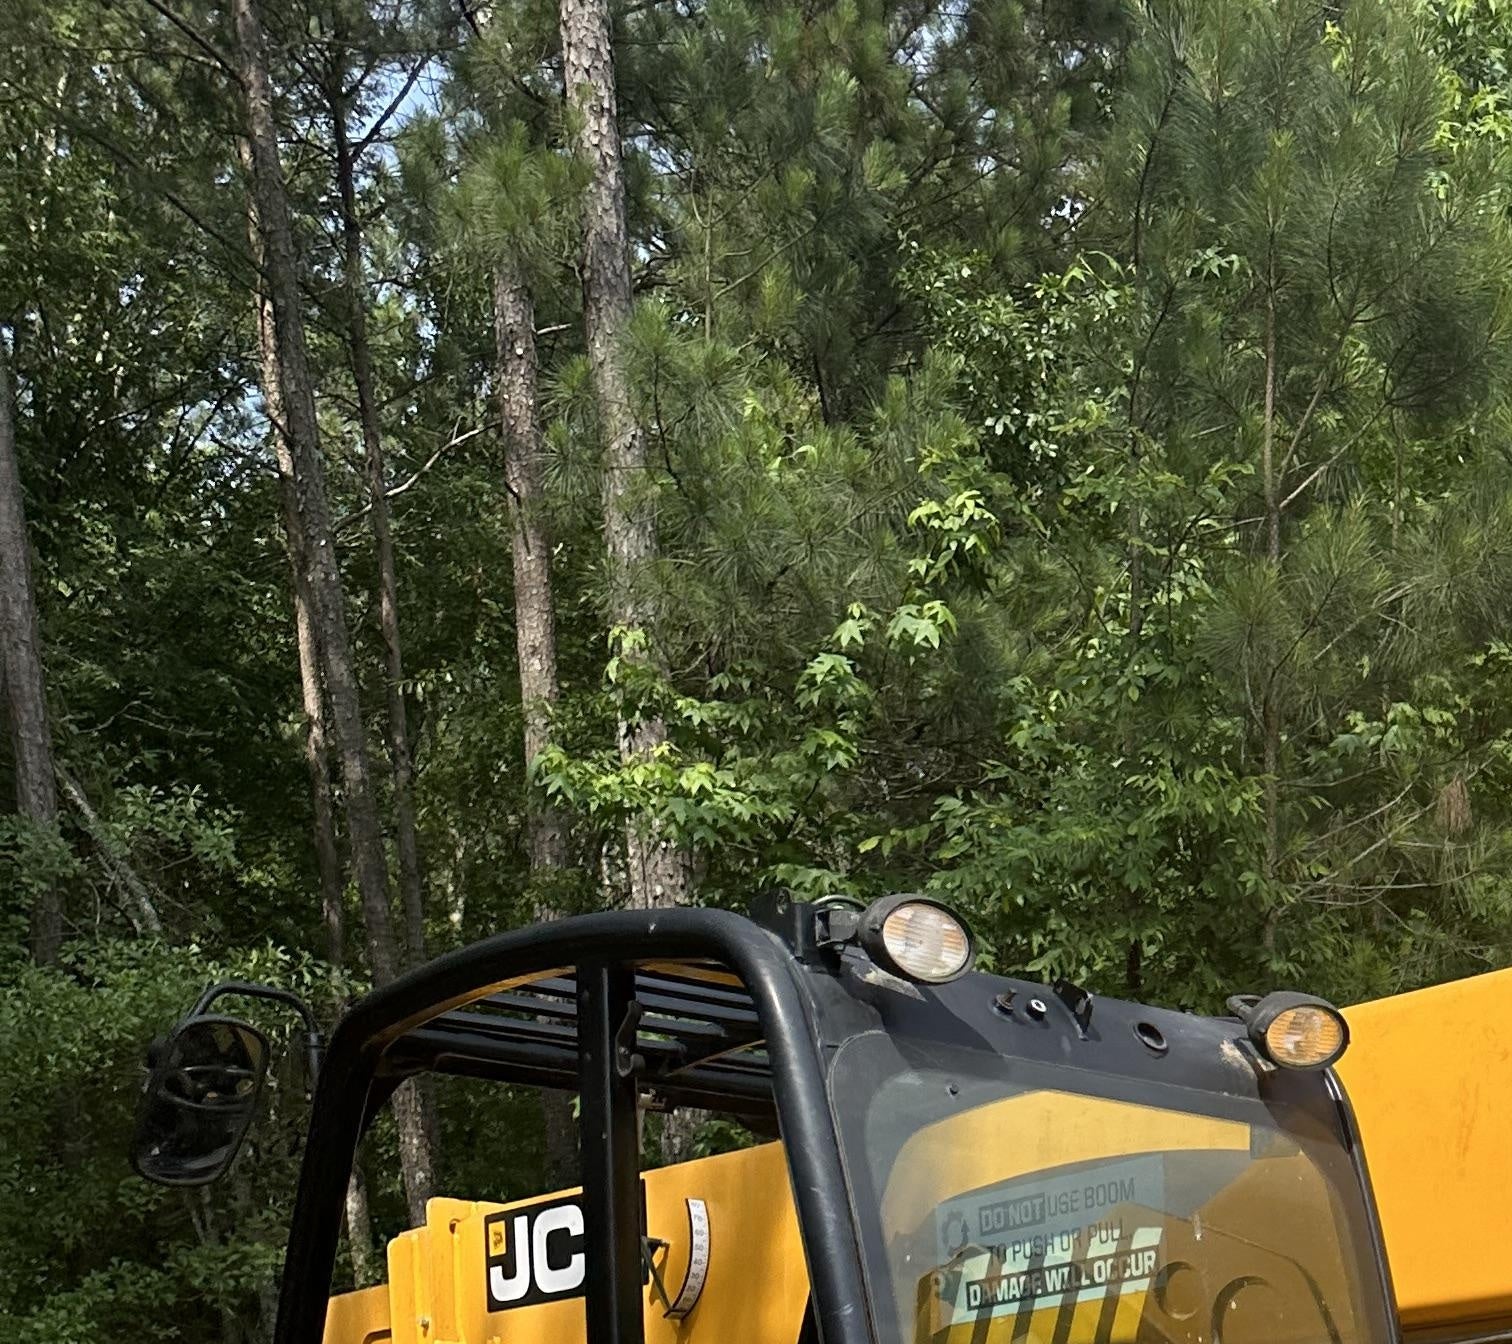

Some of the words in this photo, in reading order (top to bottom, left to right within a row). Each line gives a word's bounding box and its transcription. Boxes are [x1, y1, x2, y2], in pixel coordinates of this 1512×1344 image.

[980, 1208, 1005, 1232] DO
[1007, 1197, 1045, 1227] NOT
[1047, 1190, 1080, 1218] USE
[1084, 1179, 1135, 1208] BOOM
[490, 1204, 586, 1302] JC
[1012, 1236, 1055, 1263] PUSH
[1059, 1227, 1082, 1253] OR
[969, 1274, 1041, 1307] DAMAGE
[1044, 1264, 1092, 1293] WILL
[1093, 1249, 1158, 1284] OCCUR
